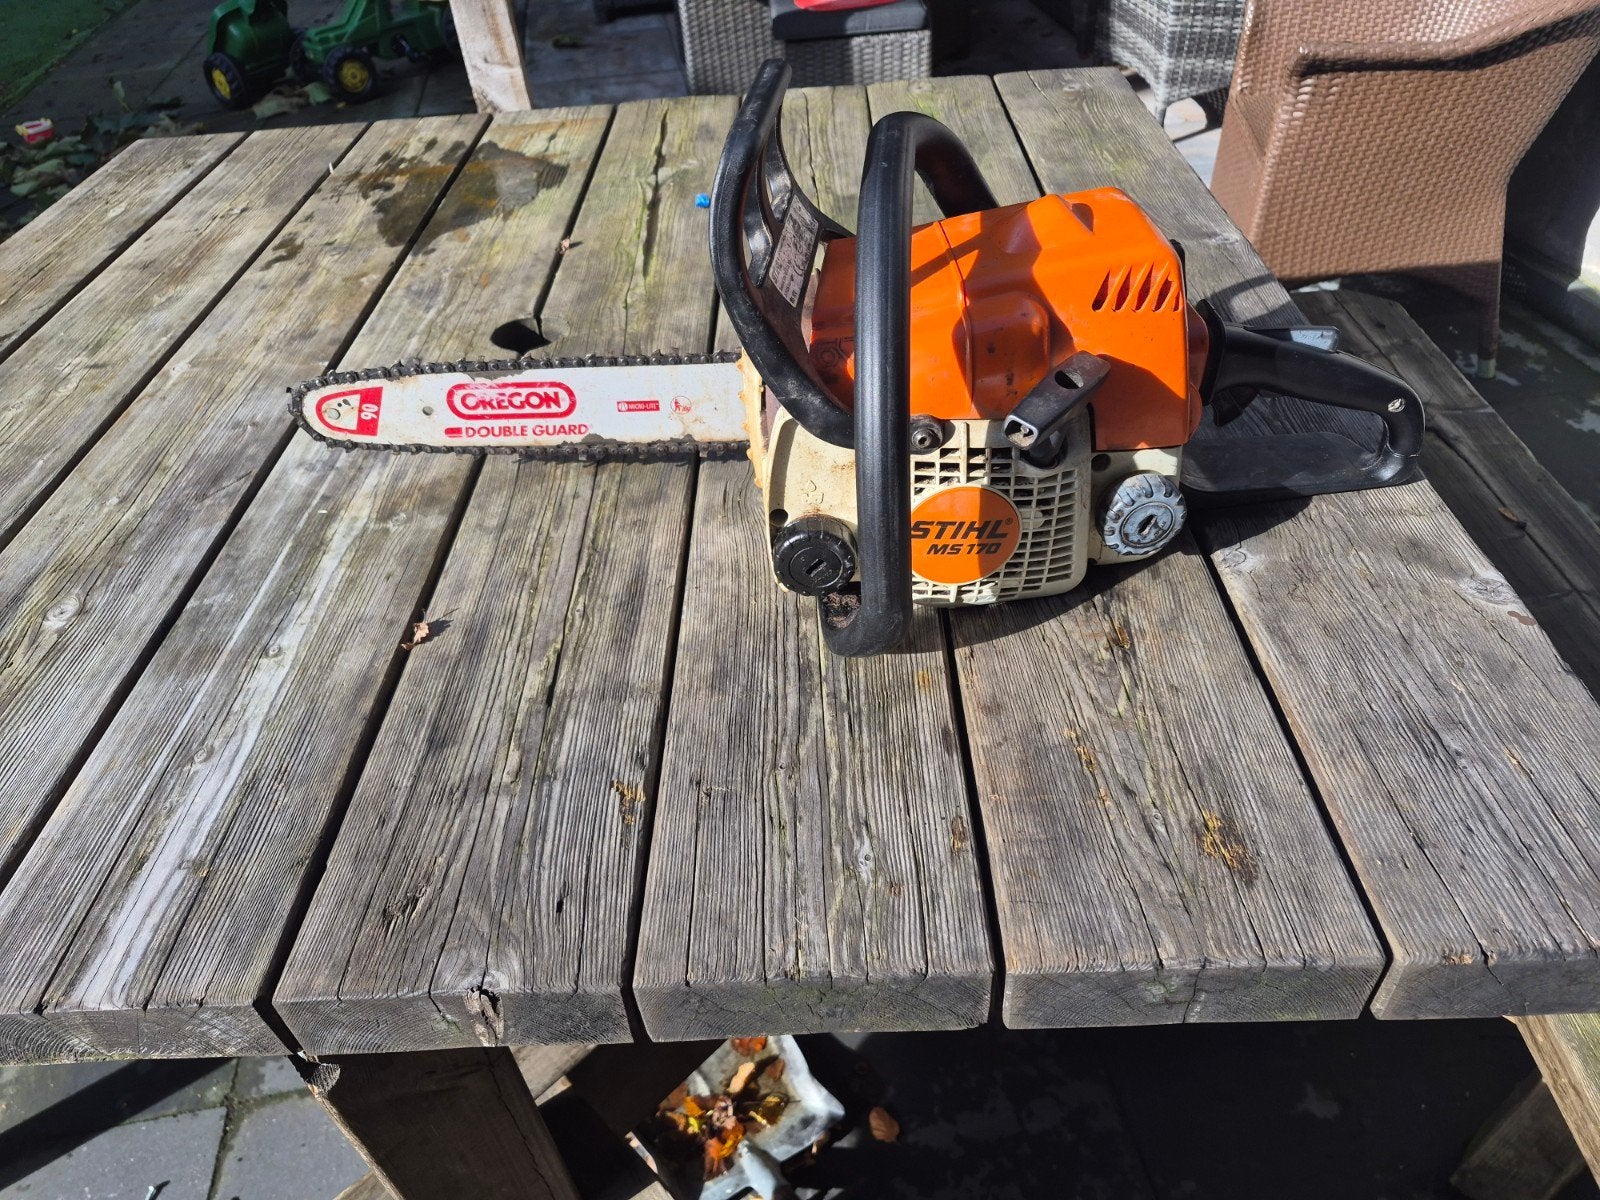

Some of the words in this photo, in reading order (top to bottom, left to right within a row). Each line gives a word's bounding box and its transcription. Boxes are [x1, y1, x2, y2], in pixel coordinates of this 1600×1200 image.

[461, 391, 562, 410] OREGON
[465, 426, 528, 438] DOUBLE
[532, 424, 589, 436] GUARD
[927, 543, 963, 555] MS
[966, 543, 1002, 555] 170
